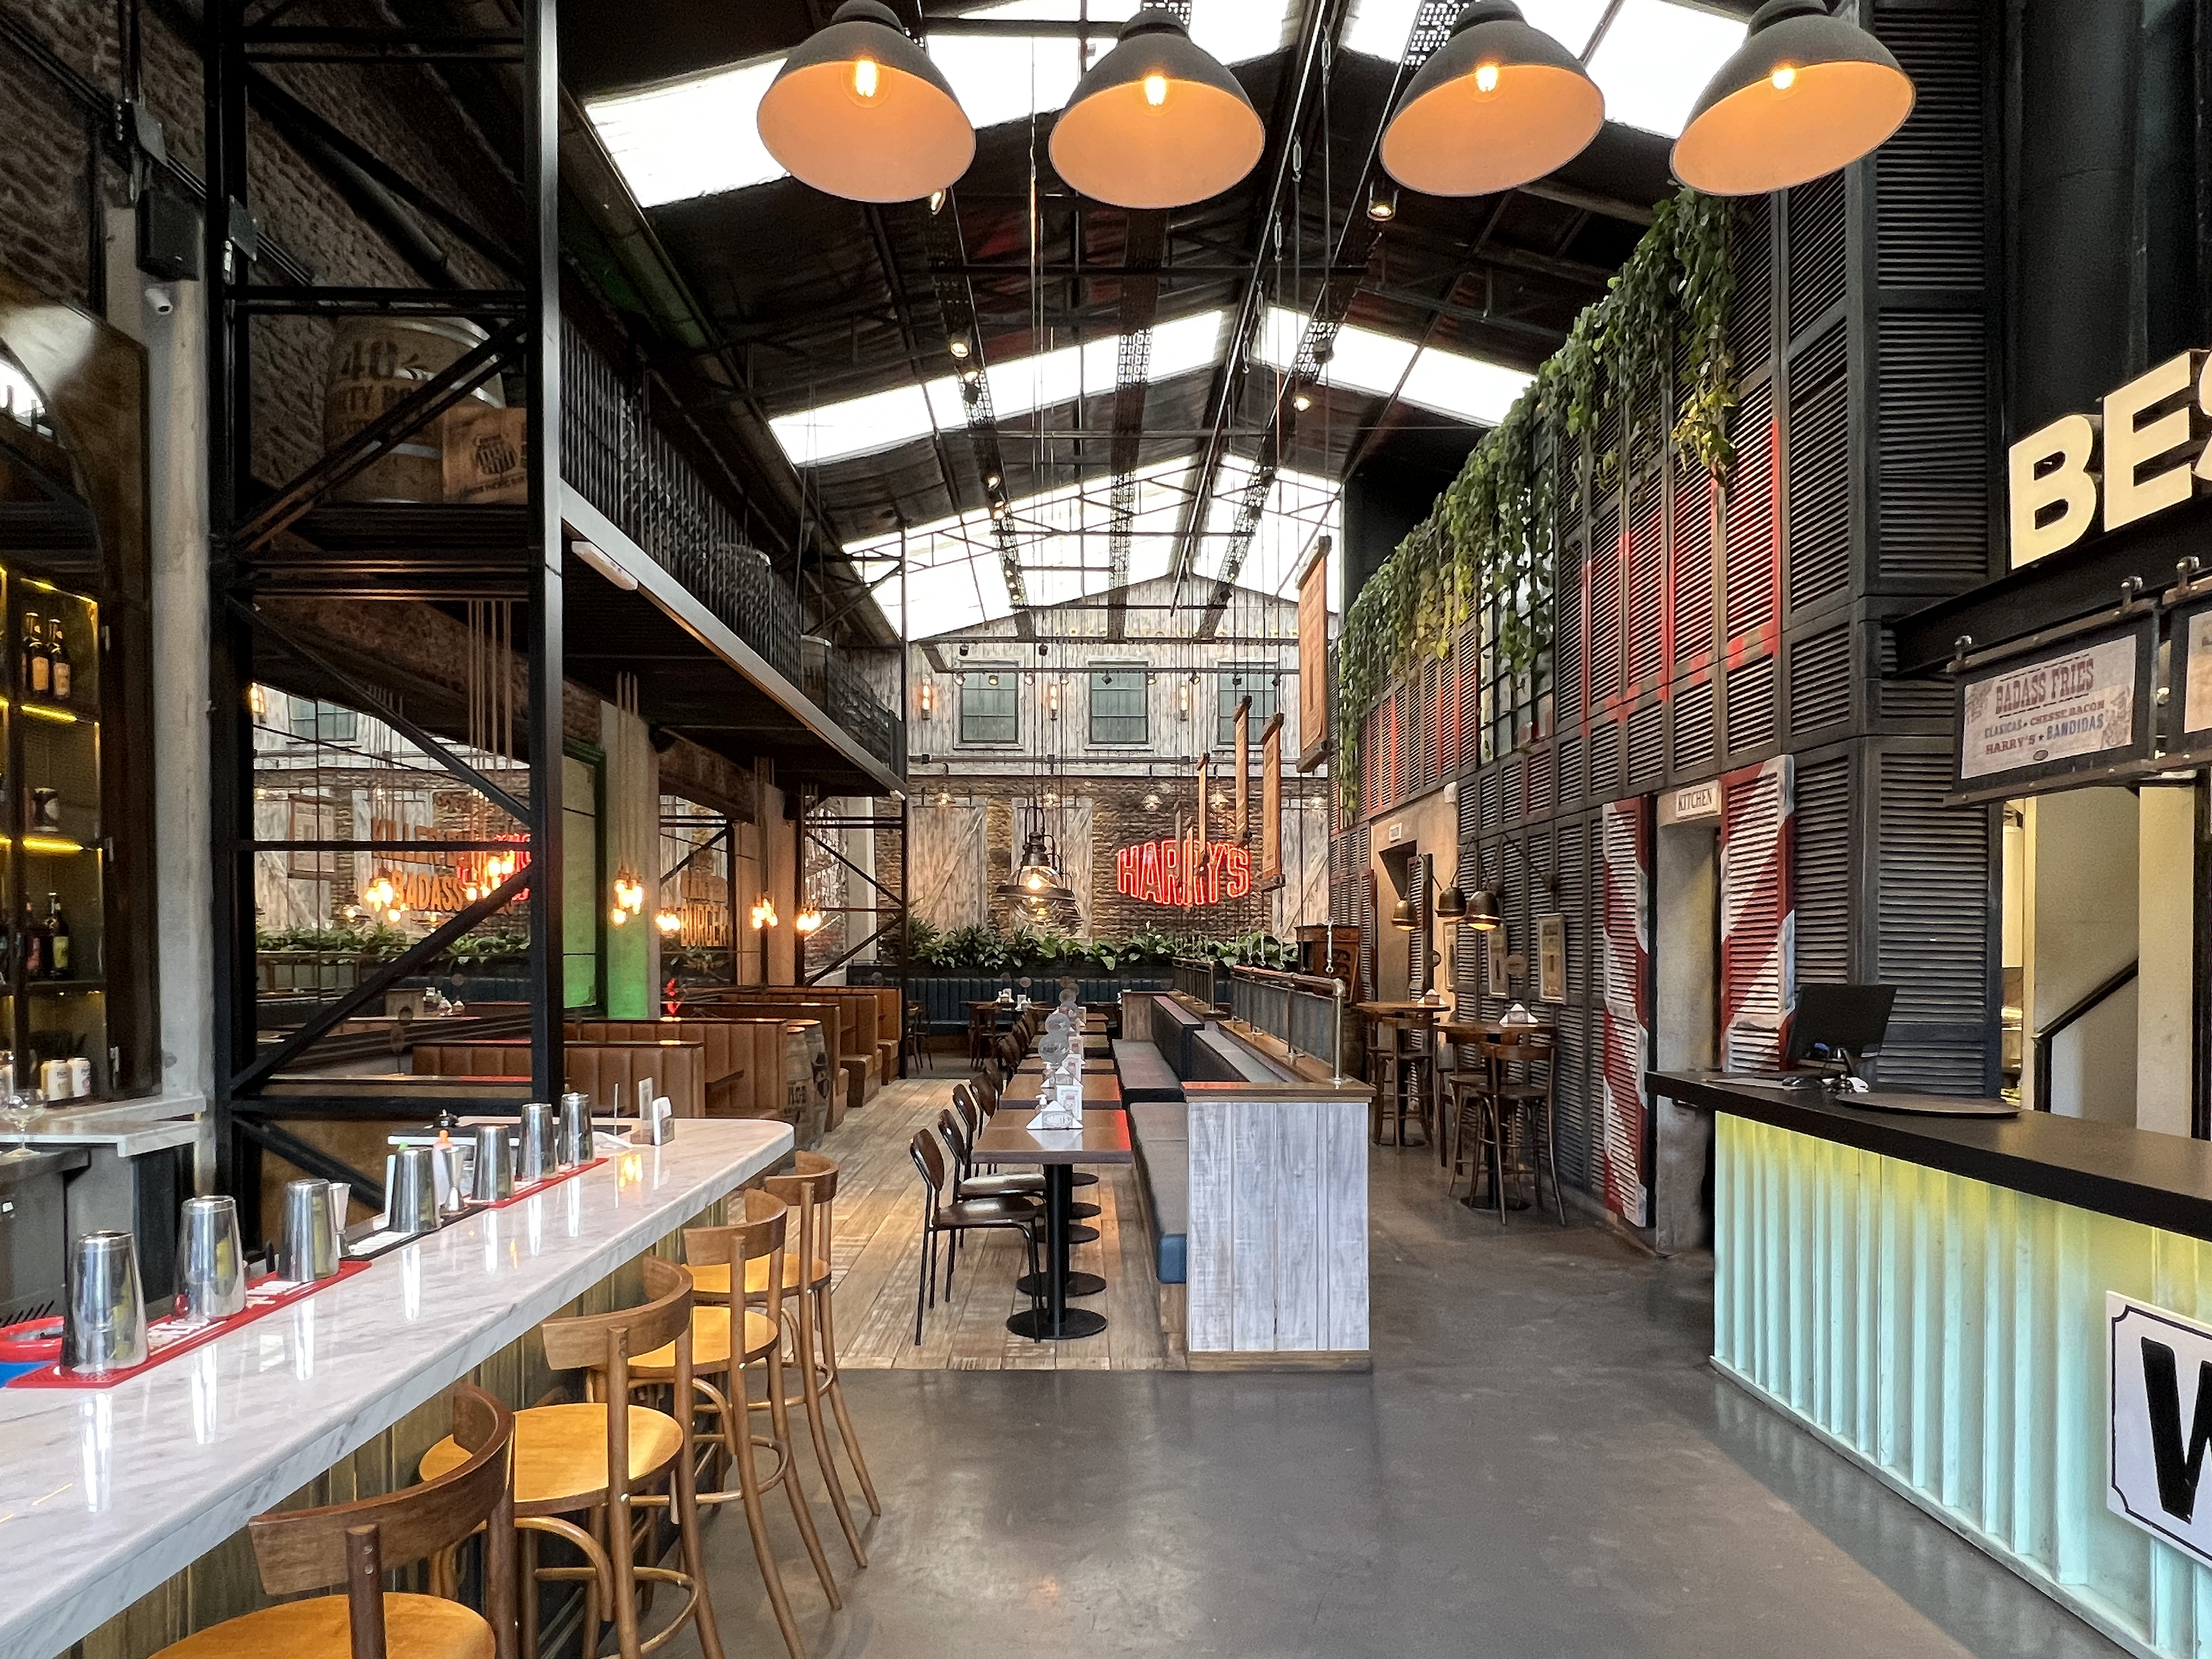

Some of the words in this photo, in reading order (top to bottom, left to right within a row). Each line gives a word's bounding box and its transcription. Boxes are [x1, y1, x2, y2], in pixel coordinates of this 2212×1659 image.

[1996, 673, 2046, 714] BADASS
[2052, 659, 2094, 699] FRIES
[2069, 701, 2104, 716] BACON
[1986, 735, 2036, 754] HARRY'S
[2047, 714, 2104, 740] BANDIDAS
[1679, 788, 1712, 811] KITCHEN
[392, 870, 464, 911] BADASS
[1117, 839, 1250, 906] HARRY'S
